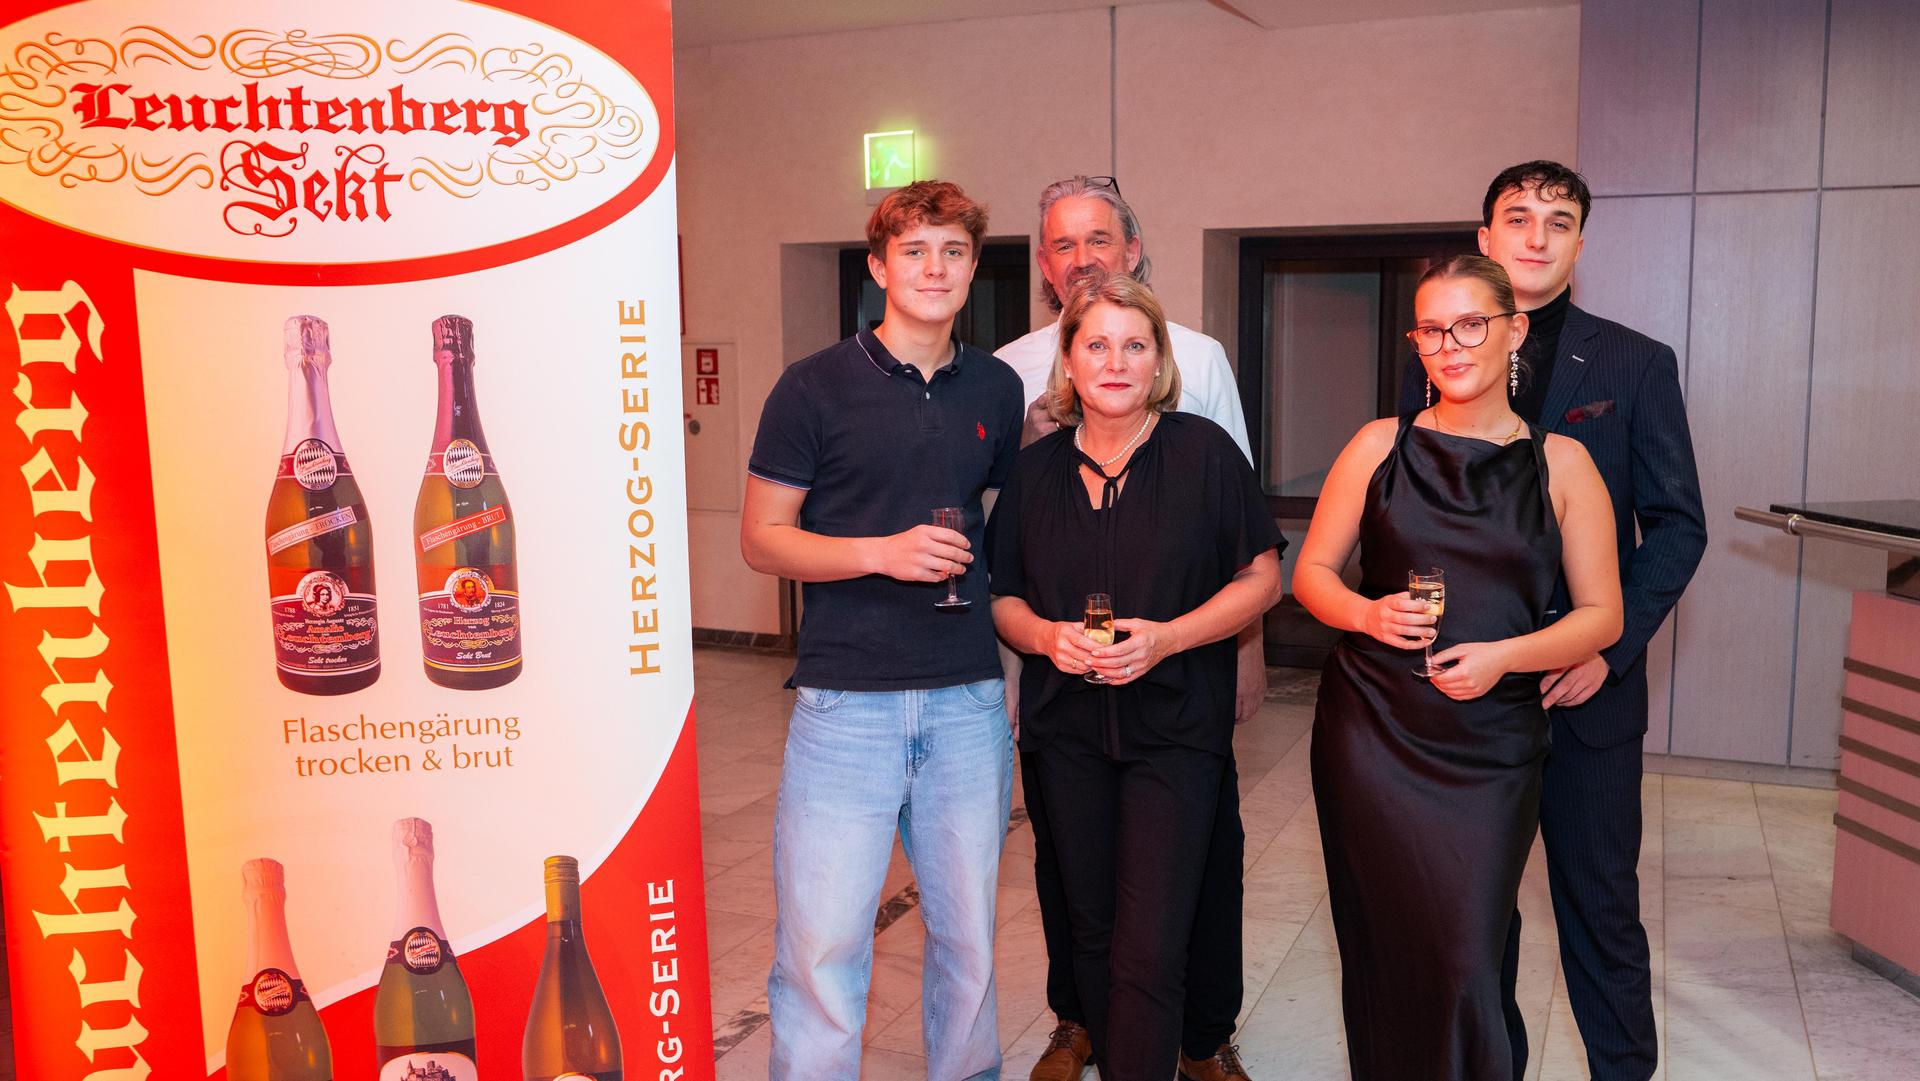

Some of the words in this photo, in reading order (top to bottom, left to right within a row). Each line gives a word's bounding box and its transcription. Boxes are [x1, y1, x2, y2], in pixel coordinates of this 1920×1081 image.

[70, 82, 529, 147] Leuchtenberg
[220, 140, 403, 237] Sekt
[618, 300, 661, 675] HERZOG-SERIE
[315, 512, 352, 530] TROCKEN
[481, 512, 500, 525] BRUT
[475, 651, 492, 659] Brut
[283, 713, 521, 744] Flaschengärung
[296, 747, 411, 777] trocken
[422, 749, 442, 771] &
[453, 744, 514, 769] brut
